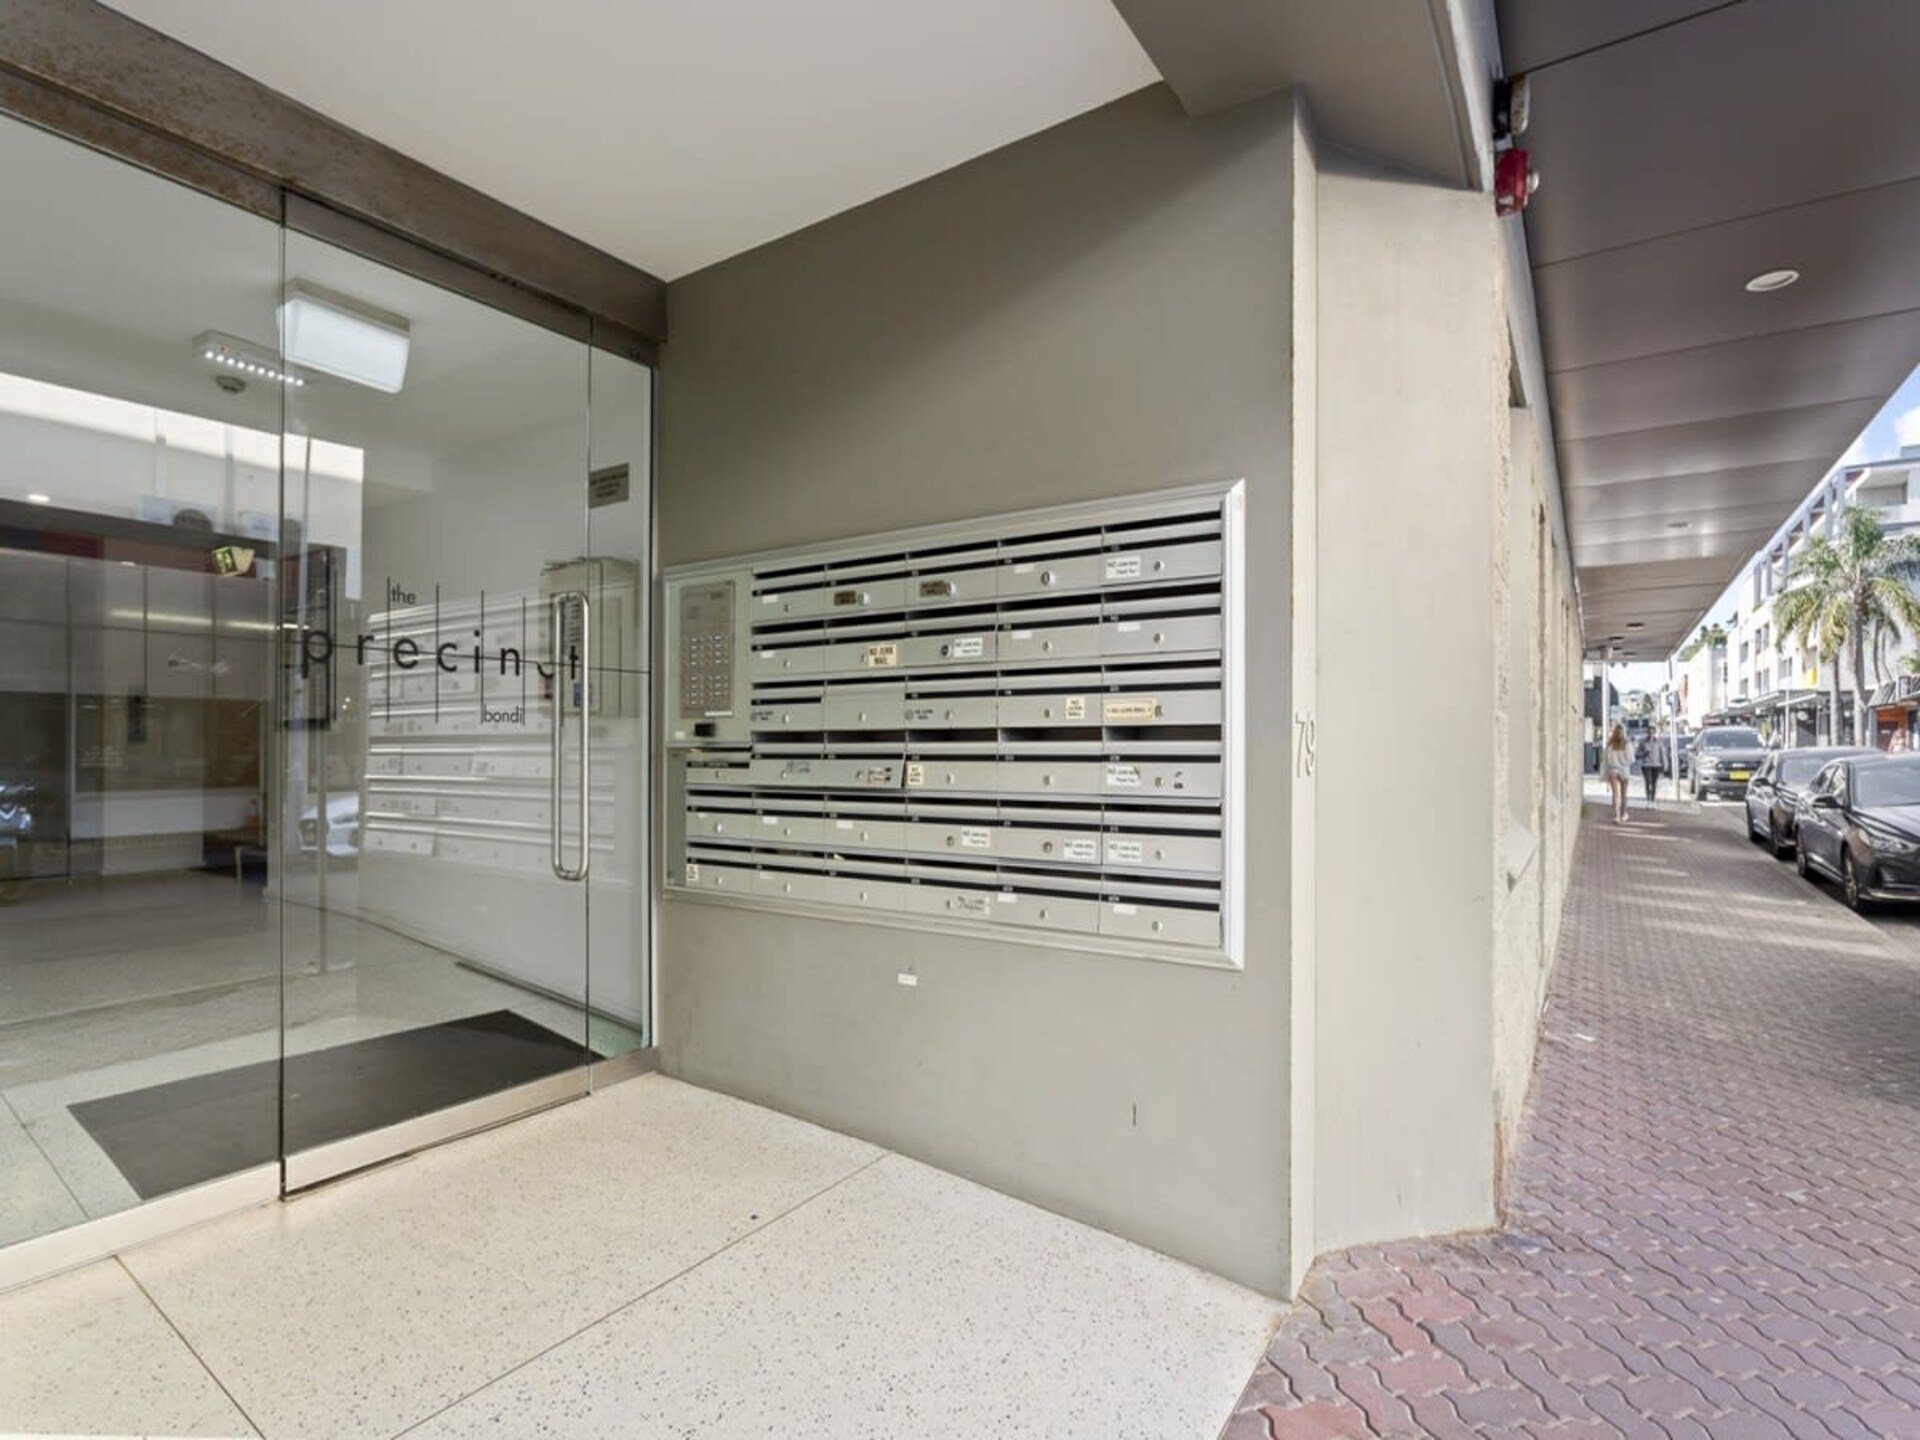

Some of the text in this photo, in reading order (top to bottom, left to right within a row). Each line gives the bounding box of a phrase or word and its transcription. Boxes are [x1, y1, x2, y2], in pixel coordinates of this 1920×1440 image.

[391, 583, 416, 604] the
[484, 704, 524, 724] bondi
[1295, 711, 1315, 778] 79
